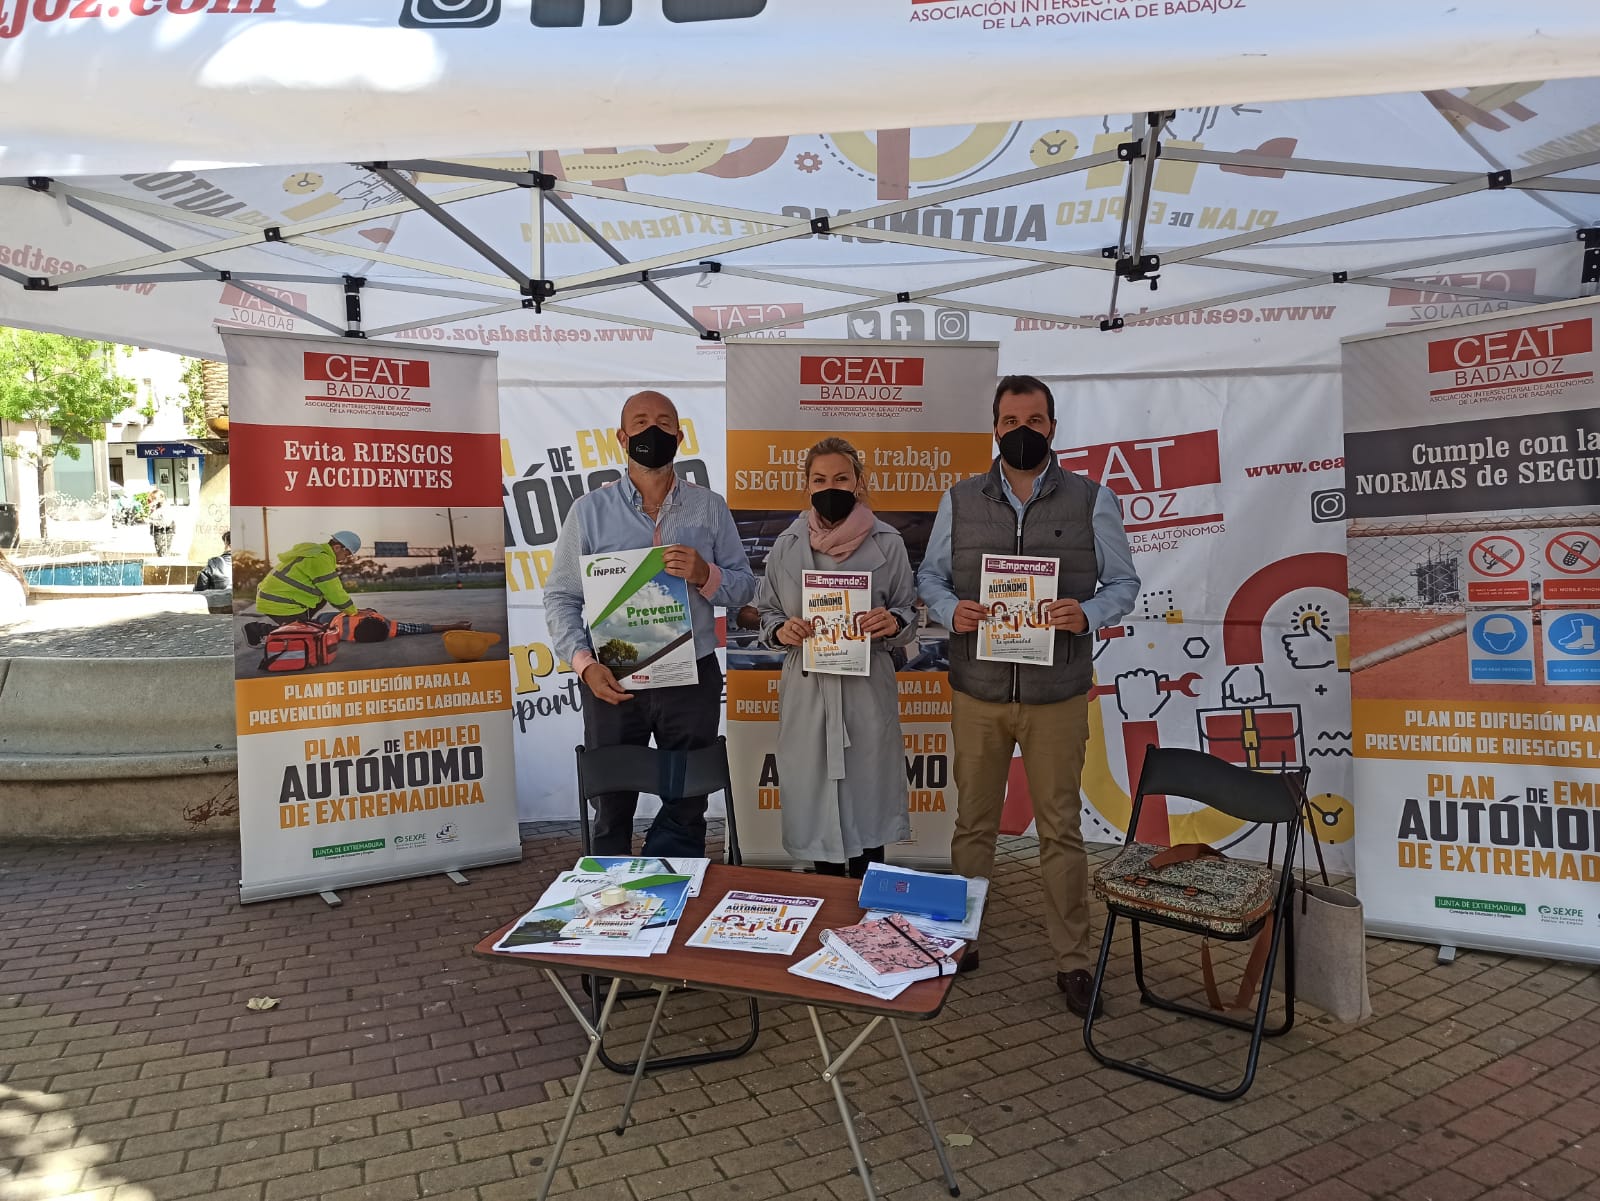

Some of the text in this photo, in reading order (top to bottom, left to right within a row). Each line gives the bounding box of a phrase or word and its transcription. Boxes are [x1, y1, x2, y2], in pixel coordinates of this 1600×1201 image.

[909, 0, 1016, 22] ASOCIACIÓN
[983, 0, 1246, 30] DE LA PROVINCIA DE BADAJOZ
[1453, 324, 1564, 367] CEAT
[325, 355, 410, 385] CEAT
[820, 357, 904, 385] CEAT
[1455, 357, 1565, 386] BADAJOZ
[327, 382, 411, 401] BADAJOZ
[820, 386, 902, 401] BADAJOZ
[284, 440, 453, 465] Evita RIESGOS
[547, 445, 576, 473] DE
[767, 445, 810, 470] Lug
[874, 446, 951, 470] trabajo
[1412, 437, 1509, 466] Cumple
[1519, 434, 1569, 456] con
[1056, 439, 1175, 491] EAT
[284, 467, 453, 491] y ACCIDENTES
[1356, 467, 1467, 495] NORMAS
[1477, 464, 1508, 487] de
[1130, 541, 1179, 554] BADAJOZ
[1133, 524, 1226, 544] DE AUTÓNOMOS
[593, 566, 627, 577] INPREX
[626, 600, 685, 618] Prevenir
[652, 613, 686, 625] natural
[284, 671, 471, 700] PLAN DE DIFUSIÓN PARA LA
[925, 681, 942, 694] LA
[249, 690, 503, 727] PREVENCIÓN DE RIESGOS LABORALES
[1405, 710, 1450, 728] PLAN
[1454, 711, 1476, 729] DE
[1480, 710, 1566, 731] DIFUSIÓN
[304, 724, 481, 761] PLAN DE EMPLEO
[1365, 733, 1472, 754] PREVENCIÓN
[1476, 737, 1498, 754] DE
[1503, 738, 1582, 759] RIESGOS
[279, 745, 484, 803] AUTÓNOMO
[1427, 773, 1495, 800] PLAN
[1526, 787, 1548, 805] DE
[279, 782, 485, 829] DE EXTREMADURA
[1398, 842, 1433, 870] DE
[1438, 898, 1524, 913] JUNTA DE EXTREMADURA
[1553, 907, 1584, 918] SEXPE
